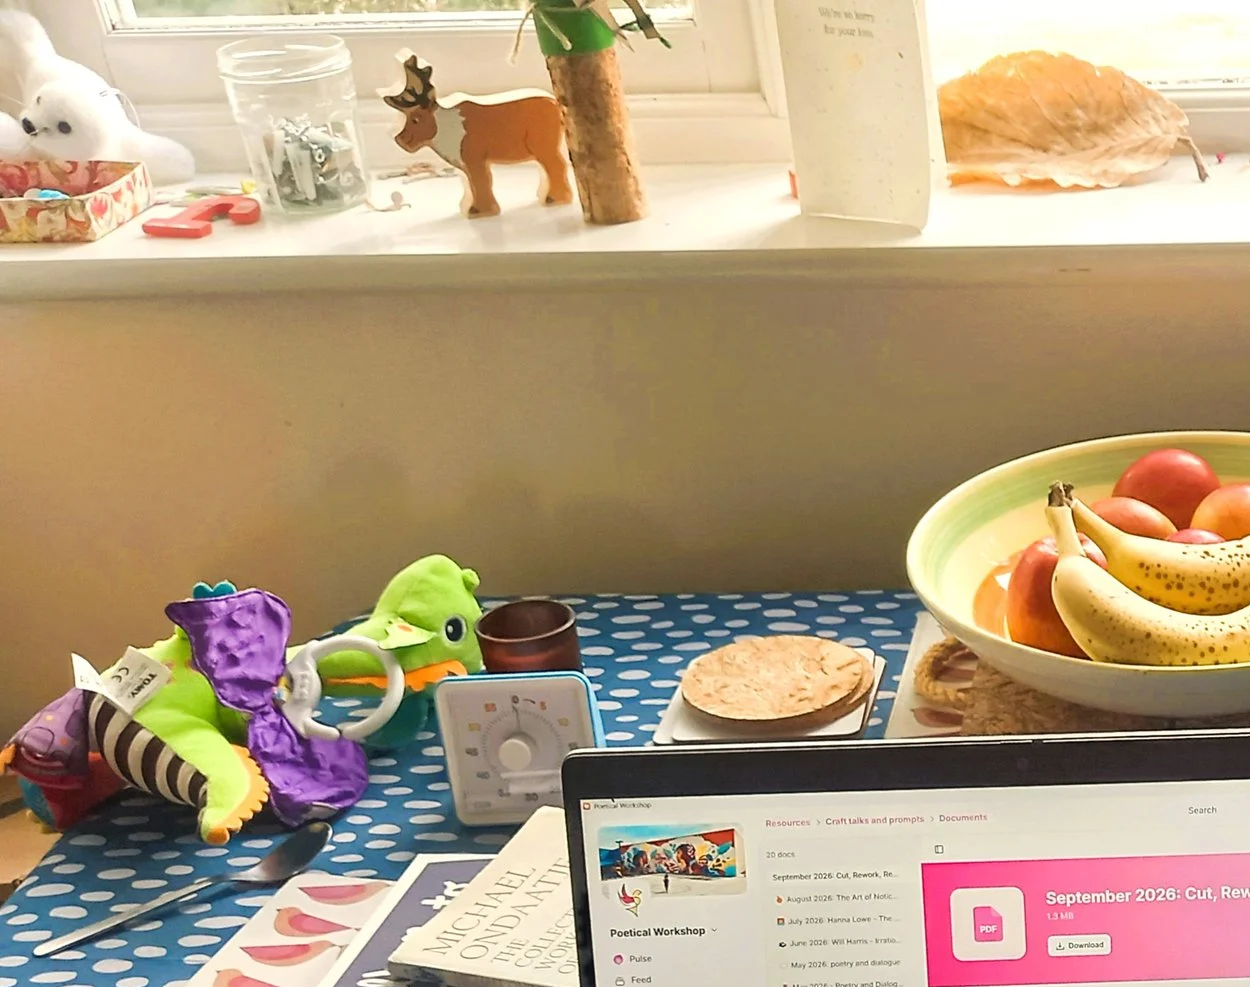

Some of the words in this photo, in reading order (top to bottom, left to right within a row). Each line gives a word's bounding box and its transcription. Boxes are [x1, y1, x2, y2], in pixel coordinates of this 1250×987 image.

[1188, 806, 1217, 815] Search
[766, 819, 811, 827] Resources
[825, 818, 847, 826] Craft
[849, 817, 869, 825] talks
[871, 816, 887, 824] and
[889, 816, 925, 826] prompts
[939, 813, 988, 823] Documents
[772, 873, 811, 882] September
[836, 872, 851, 880] Cut,
[852, 871, 882, 880] Rework,
[1046, 889, 1131, 907] September
[1135, 888, 1181, 903] 2026:
[1184, 886, 1217, 902] Cut,
[422, 866, 537, 955] MICHAEL
[1060, 912, 1074, 920] MB
[610, 927, 651, 938] Poetical
[653, 926, 706, 938] Workshop
[979, 924, 998, 934] PDF
[1068, 941, 1104, 950] Download
[490, 939, 529, 964] THE
[629, 954, 652, 963] Pulse
[631, 975, 652, 984] Feed
